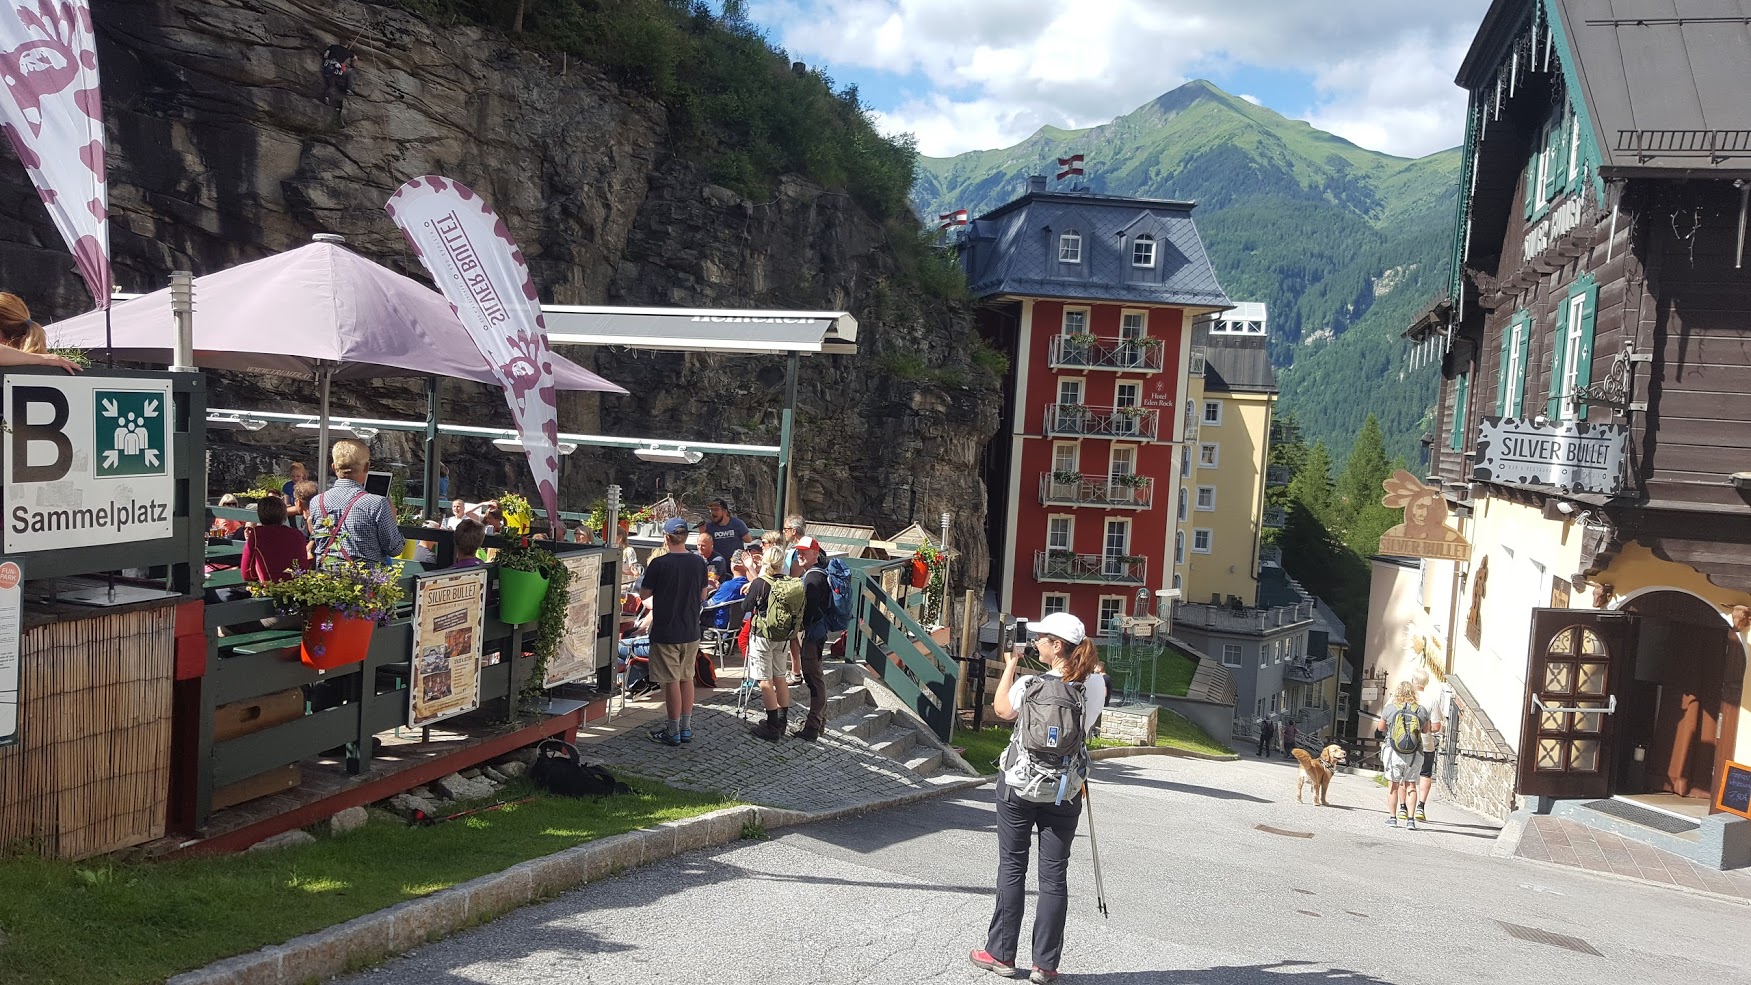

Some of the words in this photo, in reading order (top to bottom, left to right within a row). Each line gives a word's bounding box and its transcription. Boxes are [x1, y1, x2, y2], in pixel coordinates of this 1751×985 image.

[12, 386, 73, 484] B
[1500, 436, 1560, 460] SILVER
[1566, 442, 1610, 464] BULLET
[12, 498, 168, 534] Sammelplatz
[1382, 538, 1419, 553] SILVER
[1424, 542, 1468, 558] BULLET
[428, 589, 451, 604] SILVER
[453, 585, 476, 599] BULLET
